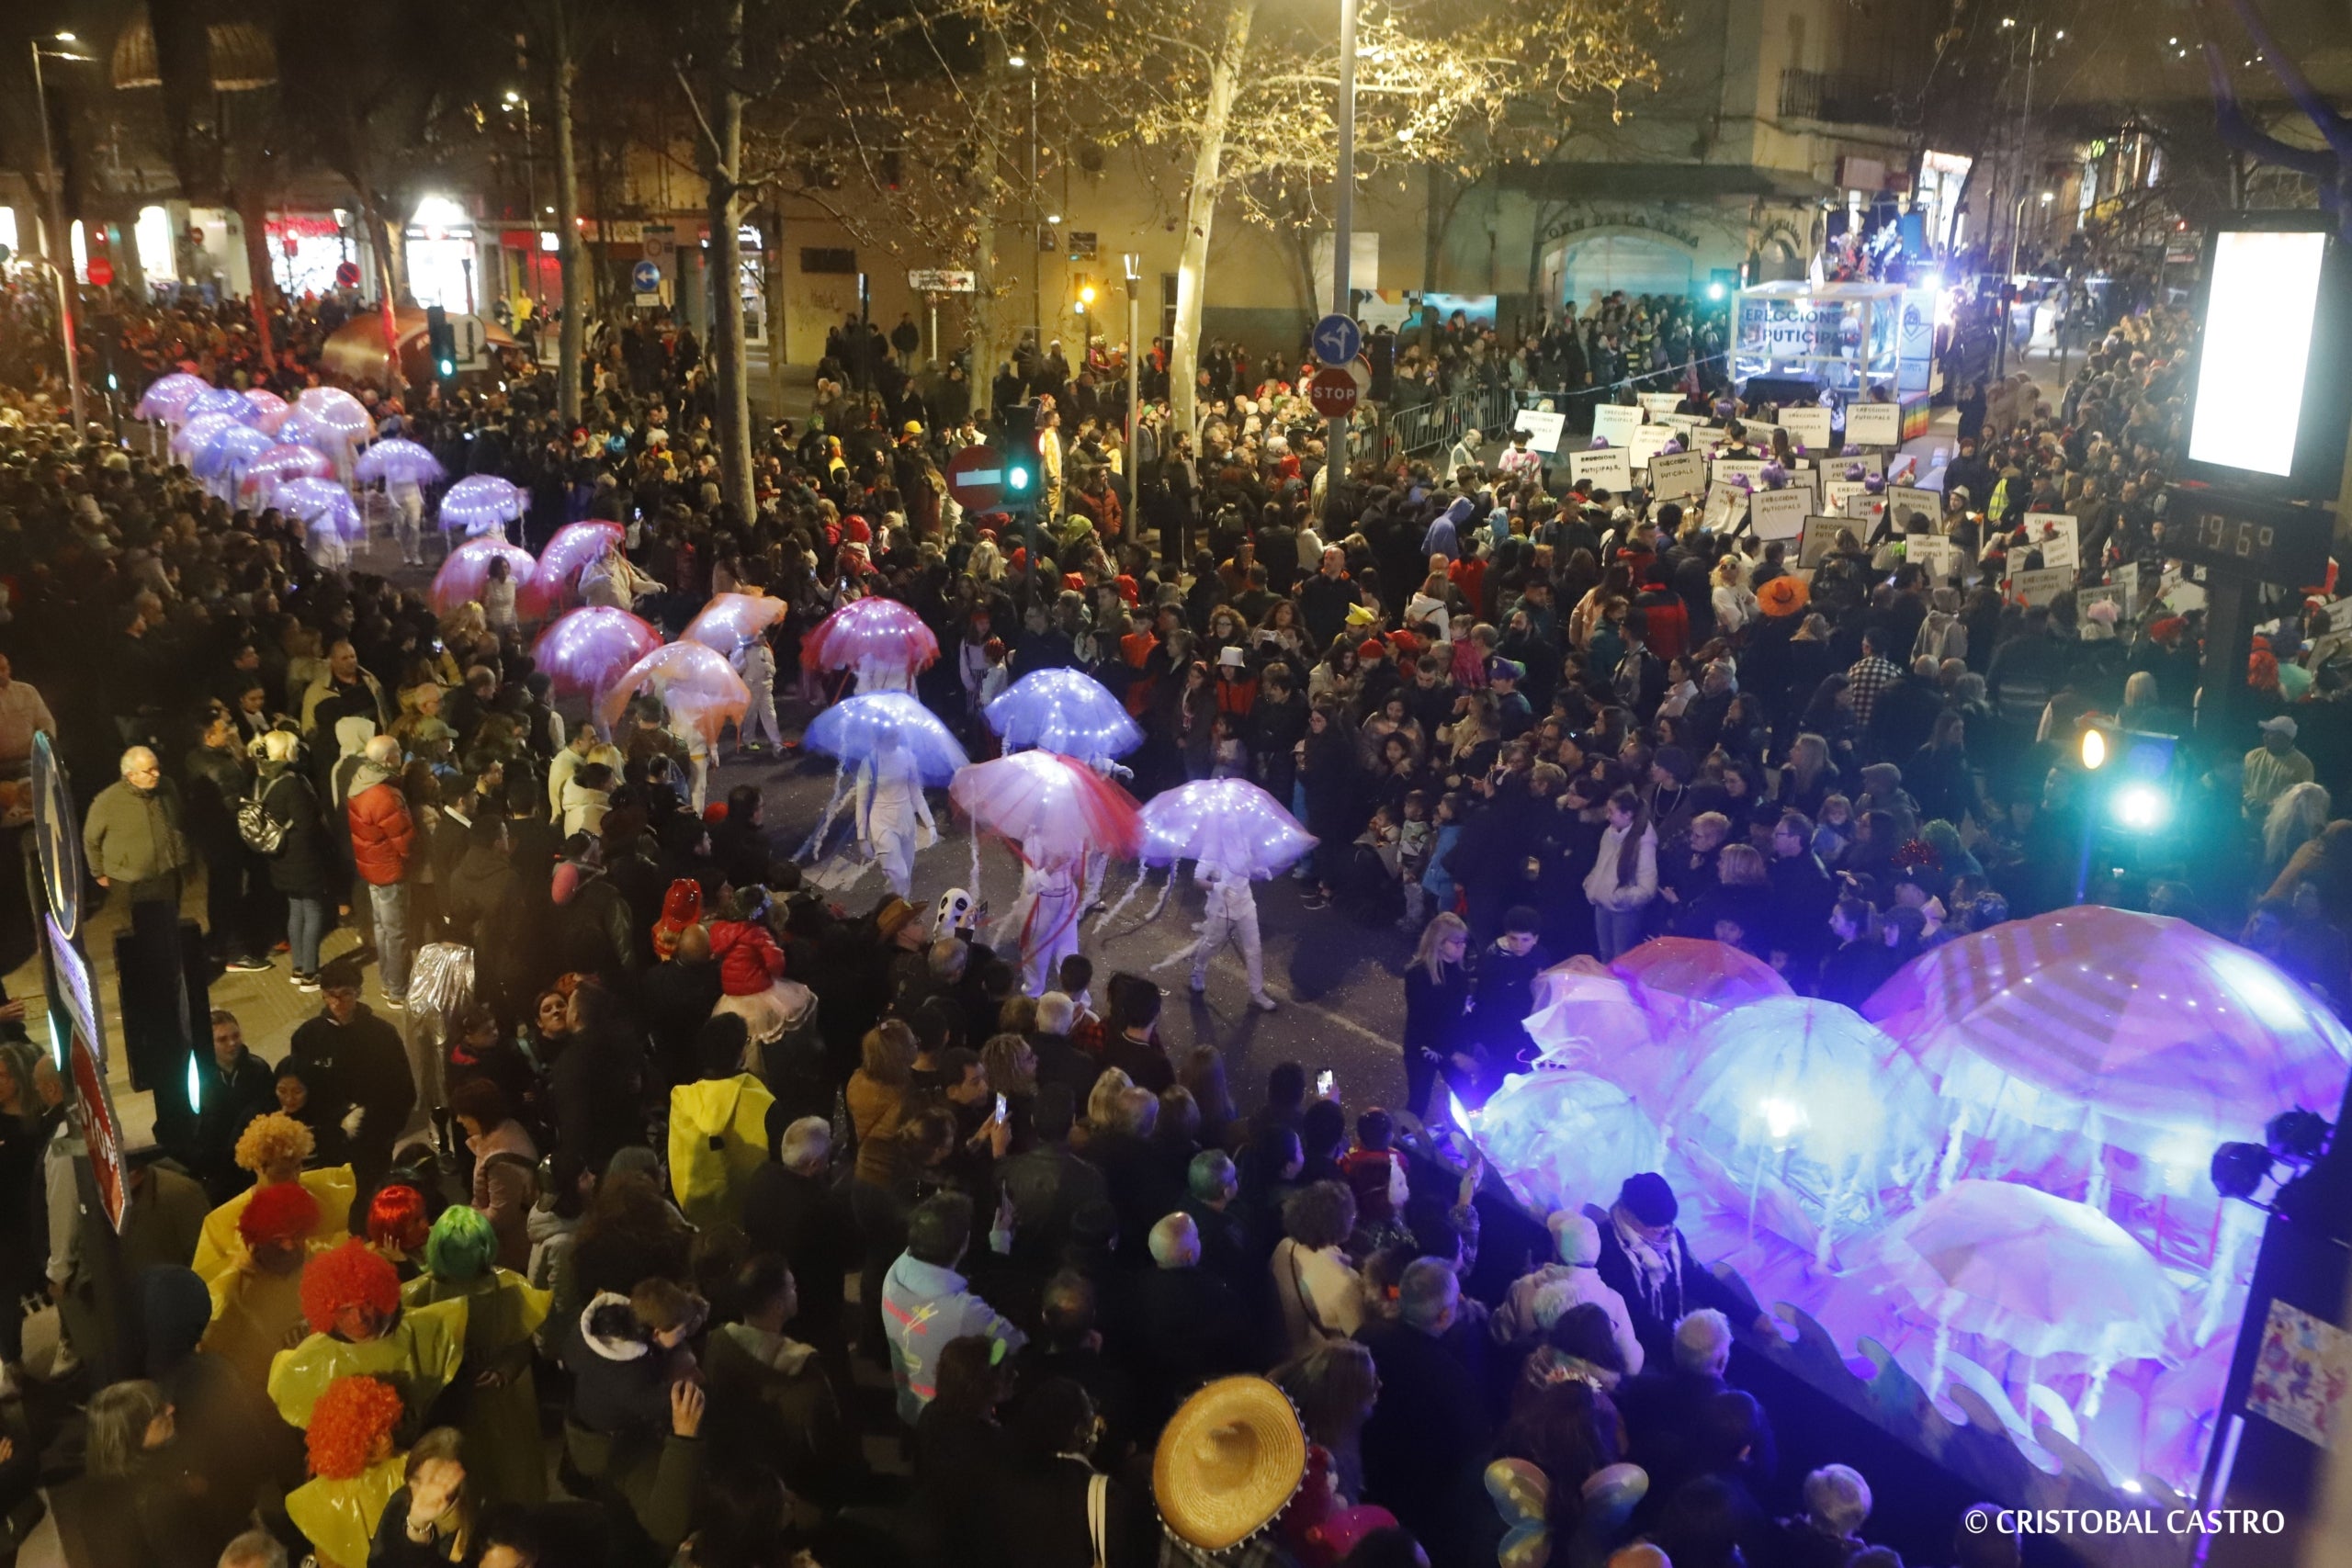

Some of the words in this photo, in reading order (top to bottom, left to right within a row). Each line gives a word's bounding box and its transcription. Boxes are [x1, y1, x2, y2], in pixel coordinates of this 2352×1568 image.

[1314, 387, 1355, 400] STOP
[1660, 469, 1694, 479] PUTICIPALS
[1761, 495, 1798, 503] ERECCIONS
[77, 1084, 116, 1173] STOP
